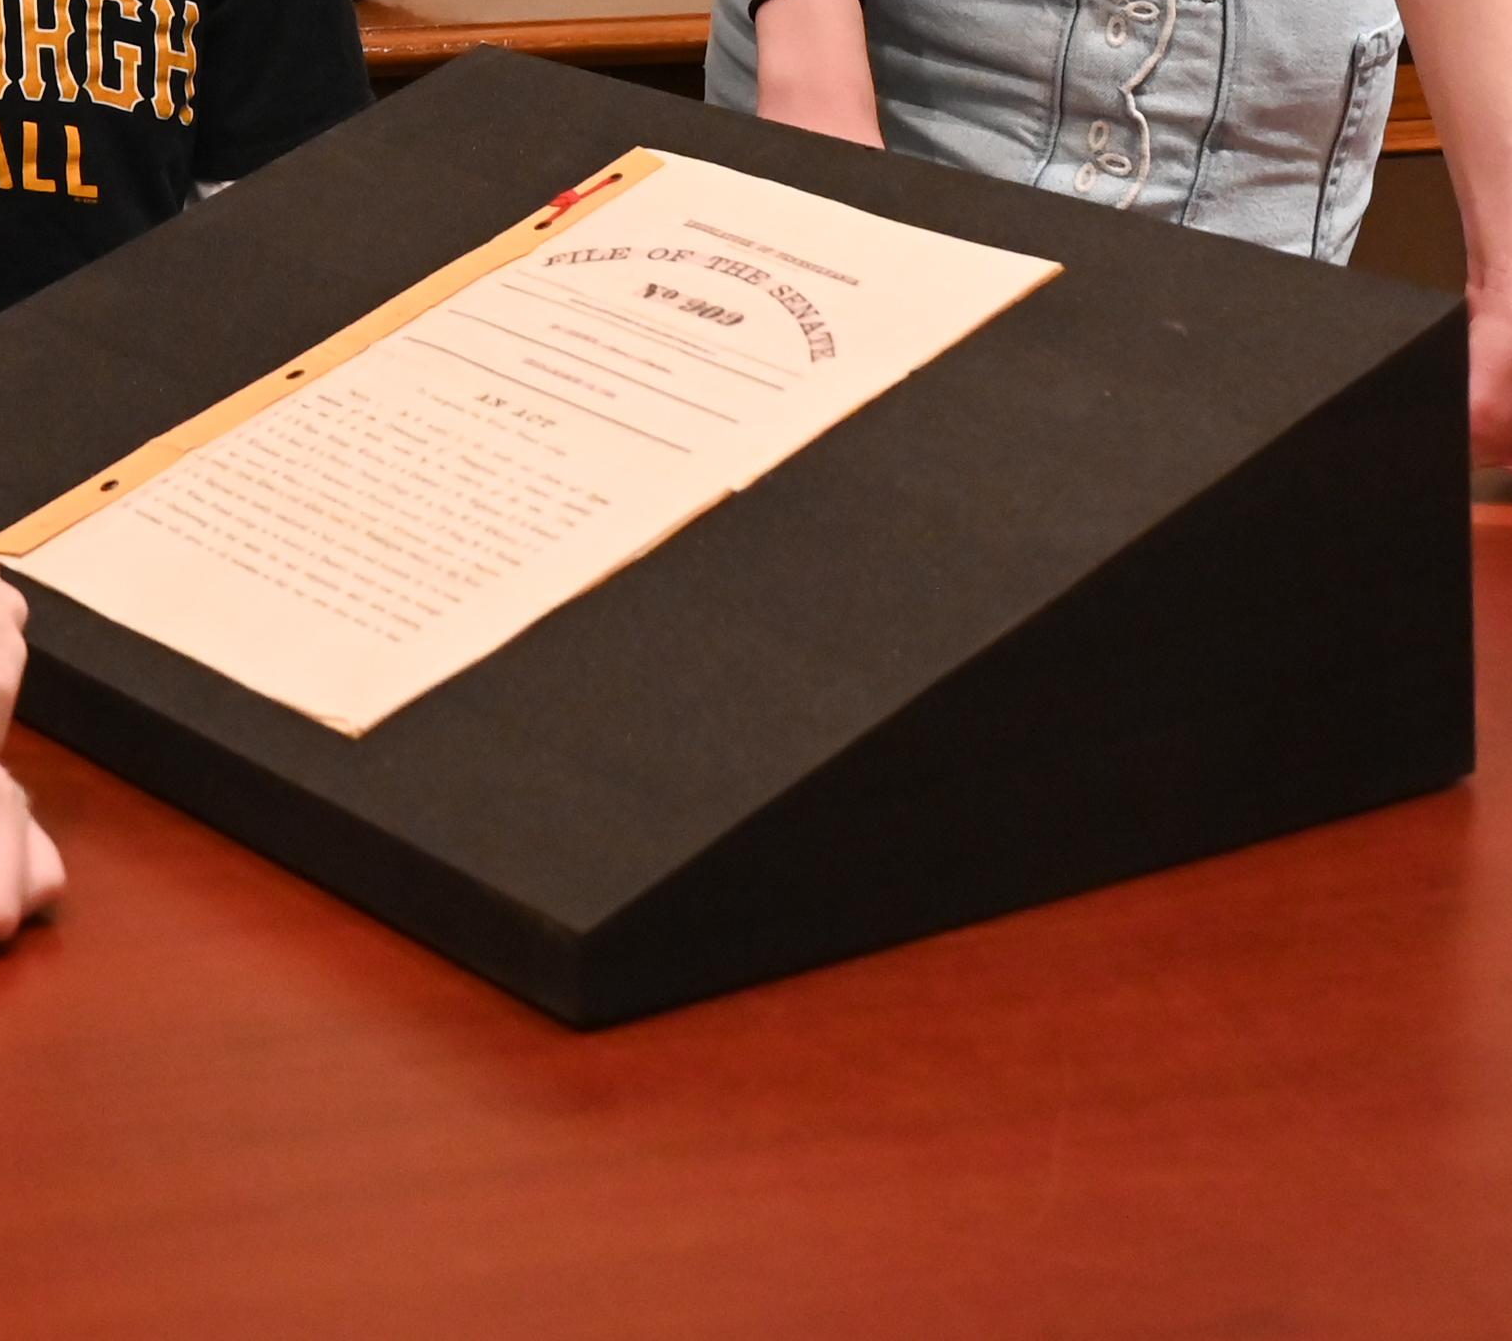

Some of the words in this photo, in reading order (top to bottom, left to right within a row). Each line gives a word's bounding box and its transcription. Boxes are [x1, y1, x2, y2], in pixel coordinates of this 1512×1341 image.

[542, 246, 631, 268] FILE
[646, 247, 695, 263] OF
[704, 255, 771, 286] THE
[769, 283, 836, 363] SENATE
